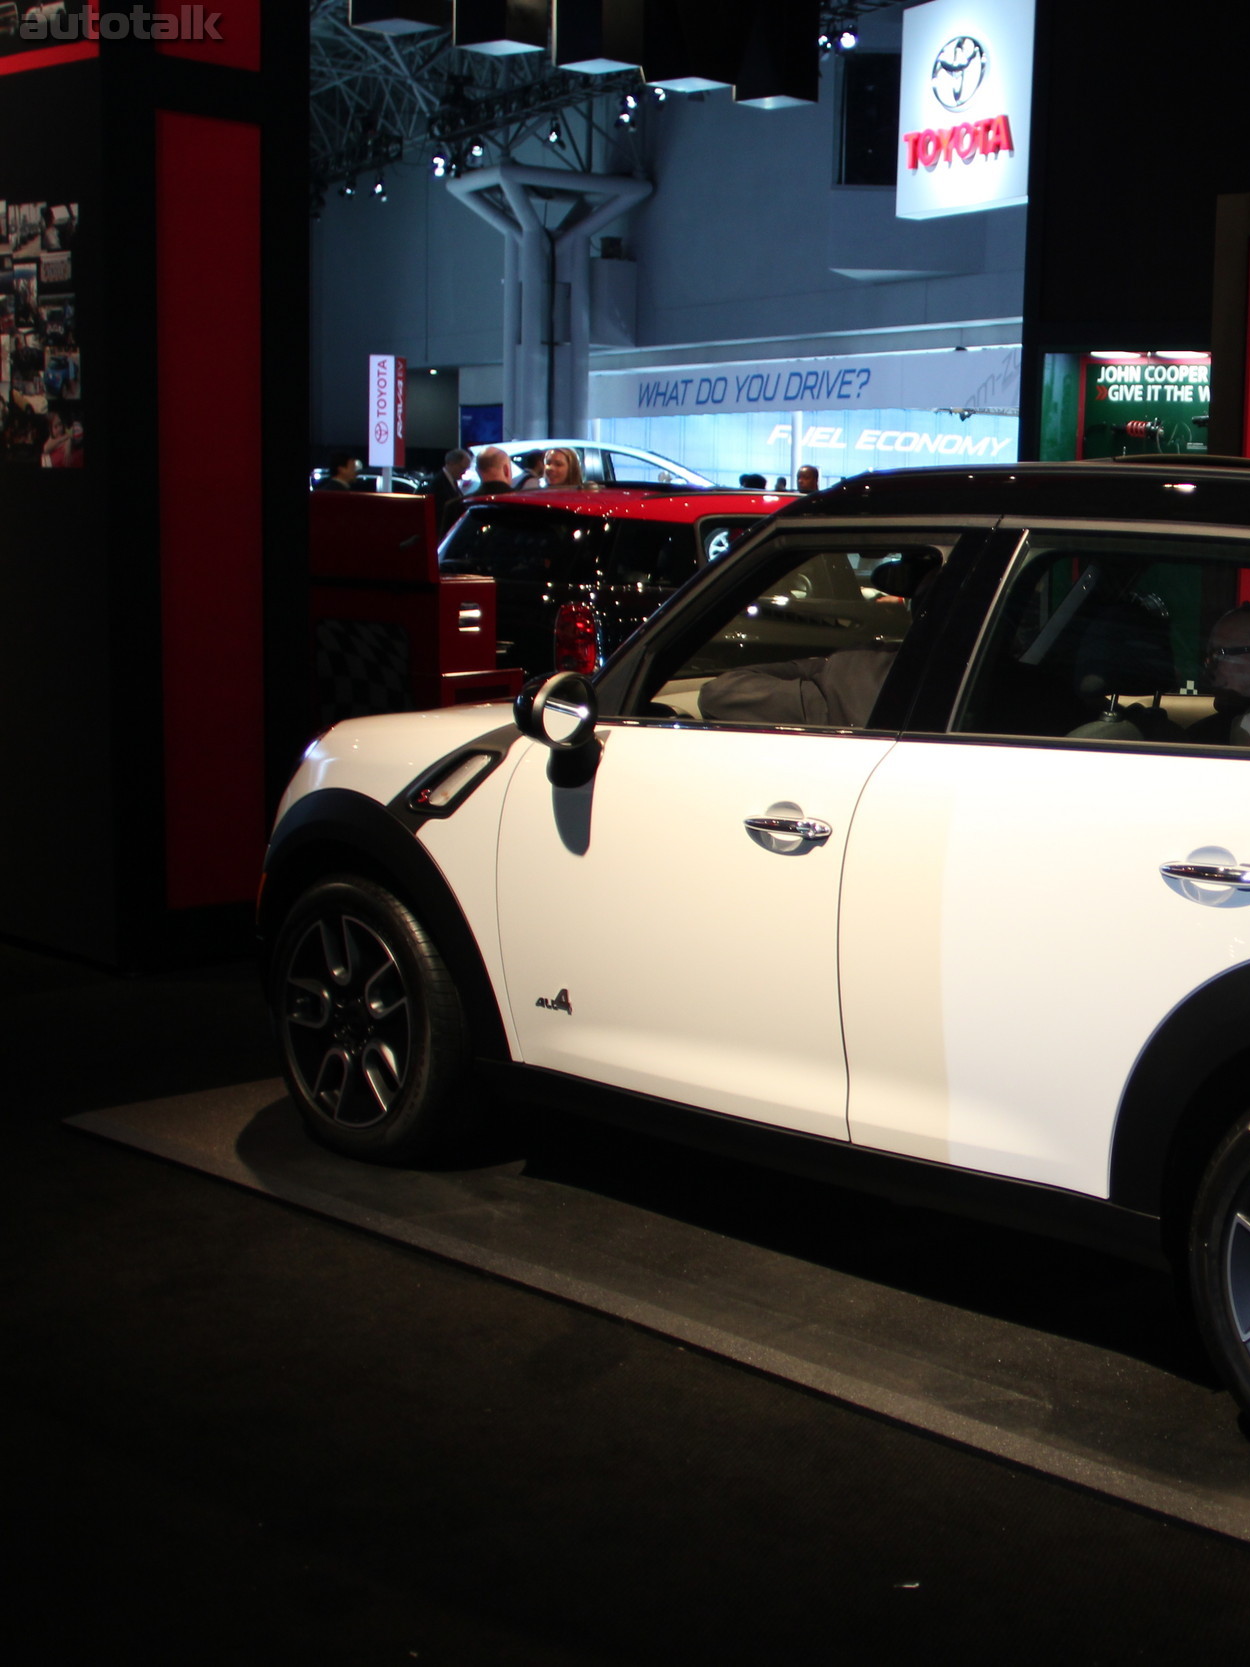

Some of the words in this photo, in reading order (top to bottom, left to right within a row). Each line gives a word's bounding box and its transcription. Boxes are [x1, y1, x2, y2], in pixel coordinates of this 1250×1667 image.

[903, 114, 1014, 170] TOYOTA
[377, 359, 387, 418] TOYOTA
[637, 378, 693, 408] WHAT
[695, 376, 728, 405] DO
[735, 372, 781, 403] YOU
[783, 368, 871, 401] DRIVE?
[1097, 365, 1141, 383] JOHN
[1144, 365, 1209, 383] COOPER
[1107, 384, 1143, 402] GIVE
[1146, 384, 1162, 402] IT
[1163, 385, 1193, 402] THE
[855, 429, 1013, 457] ECONOMY
